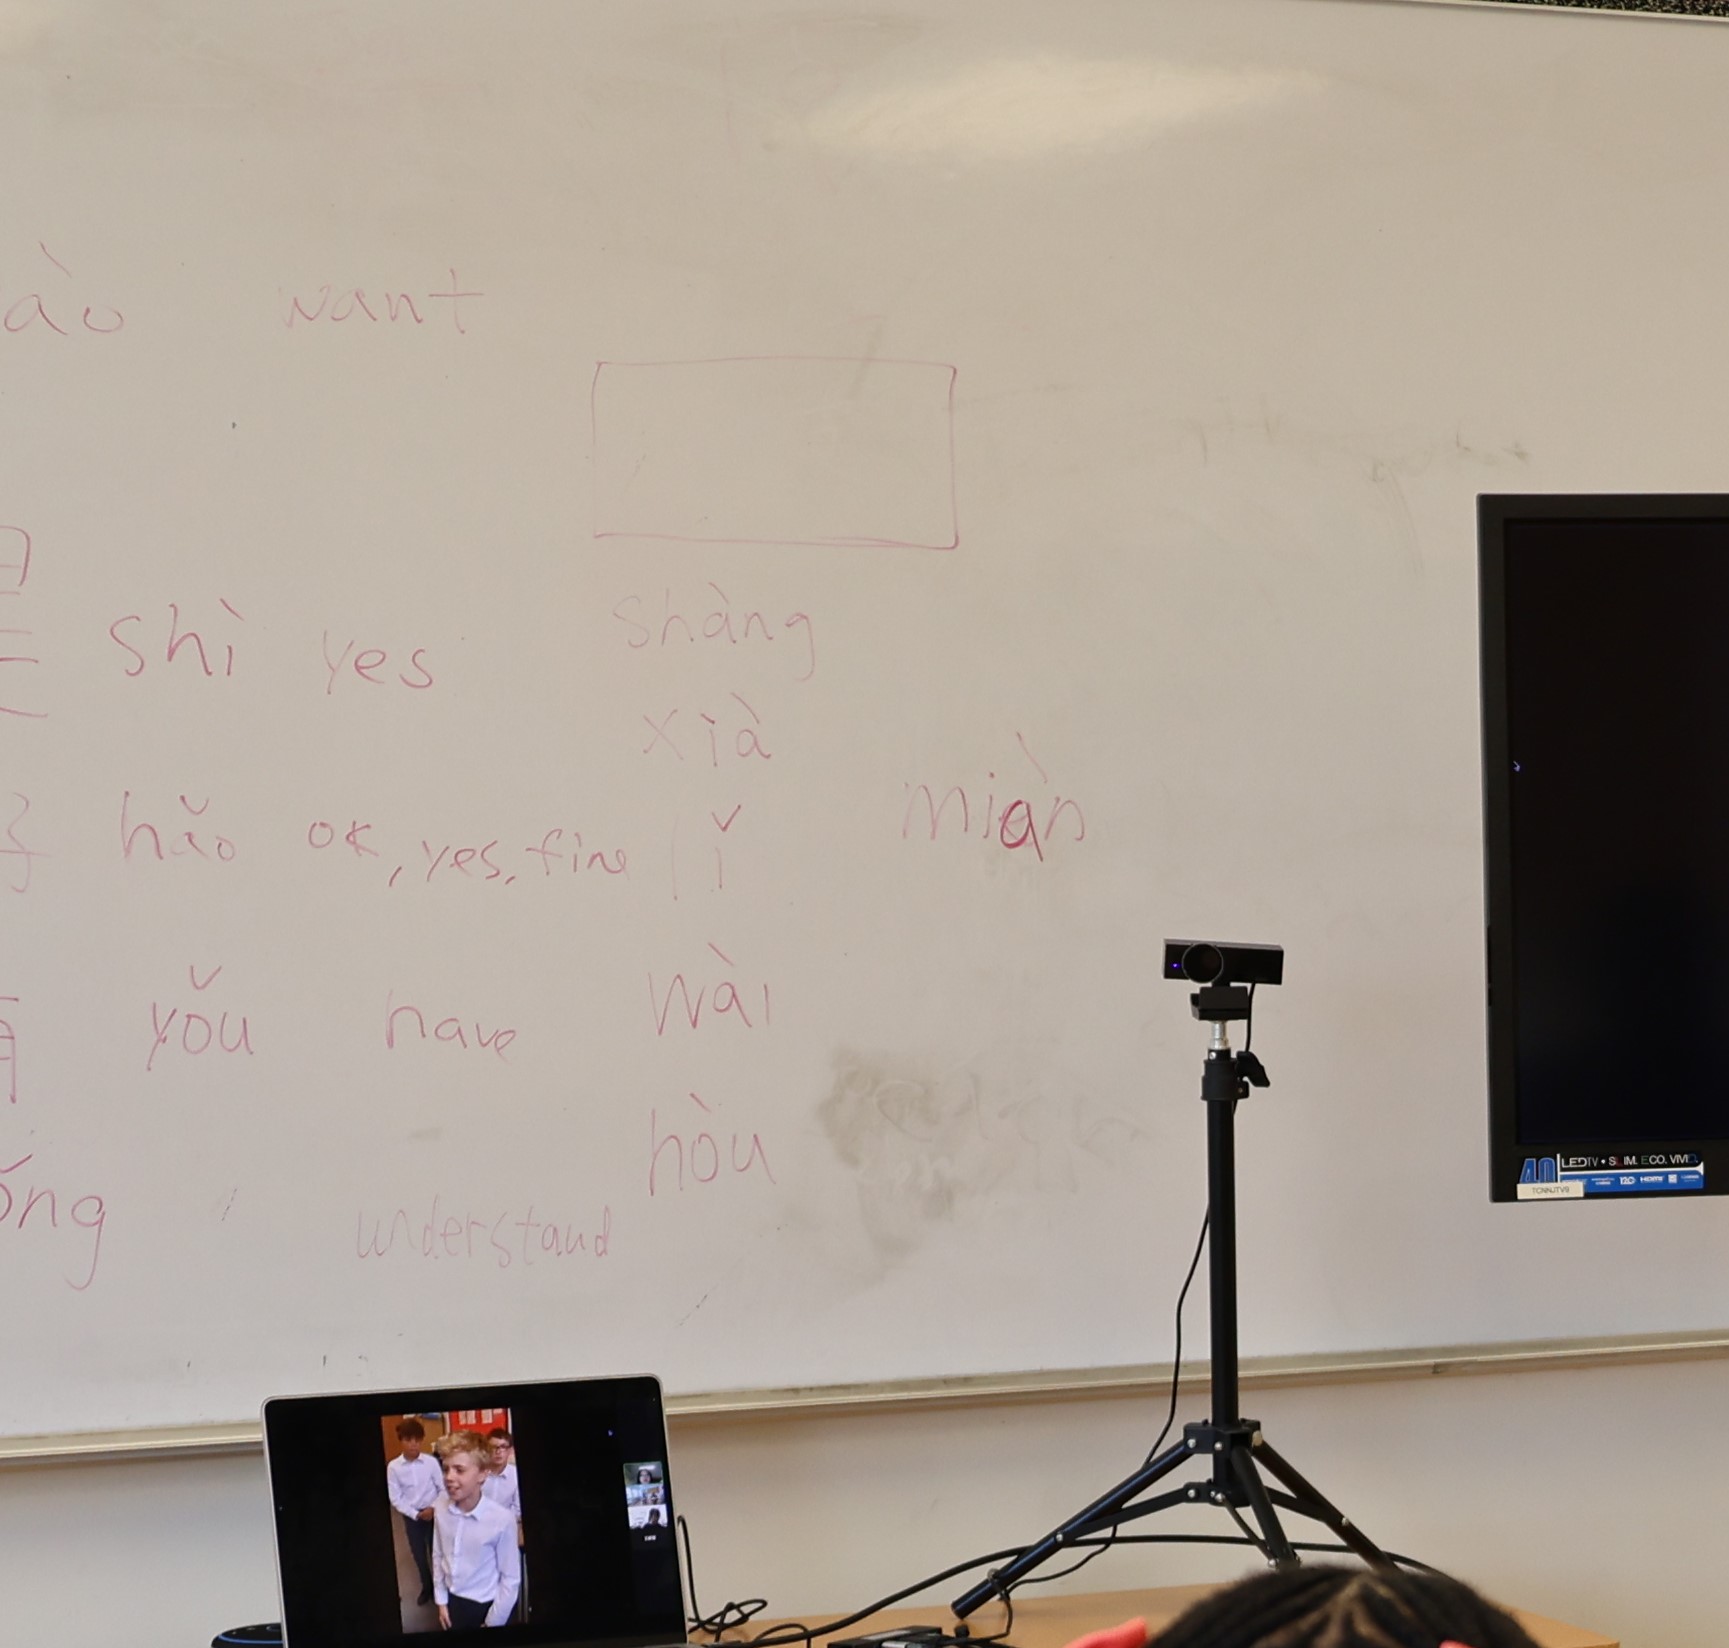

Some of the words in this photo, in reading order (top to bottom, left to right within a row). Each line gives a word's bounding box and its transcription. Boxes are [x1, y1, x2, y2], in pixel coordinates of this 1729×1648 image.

[280, 267, 486, 335] want
[525, 827, 628, 876] fine
[145, 964, 254, 1072] yǒu
[386, 988, 517, 1066] have
[649, 1092, 777, 1198] hòu
